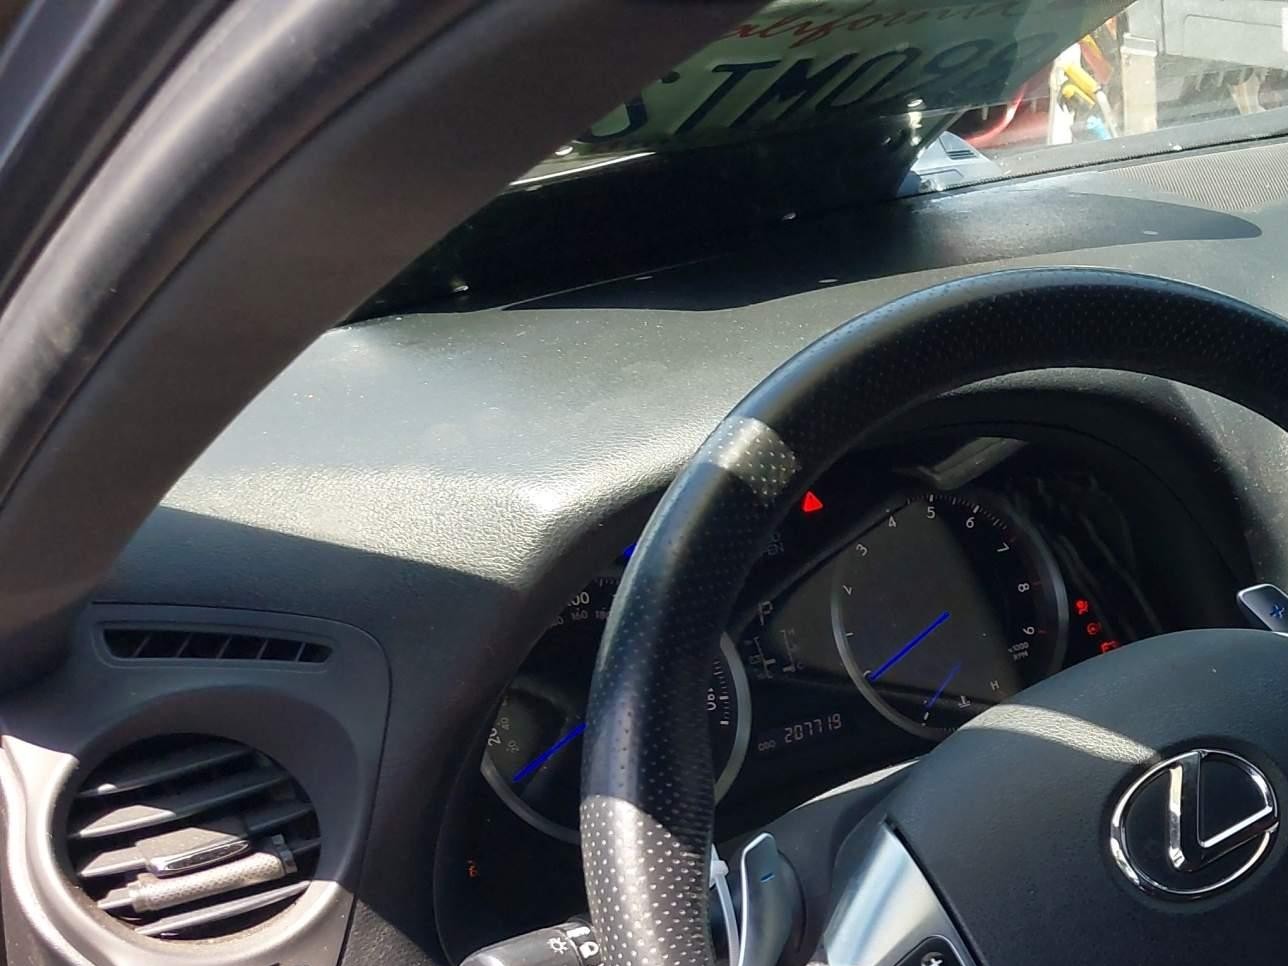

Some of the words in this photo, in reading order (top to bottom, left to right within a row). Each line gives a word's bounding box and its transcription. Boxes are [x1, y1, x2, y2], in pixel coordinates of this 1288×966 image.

[926, 506, 936, 520] 5
[887, 517, 897, 529] 4
[965, 516, 976, 530] 6
[856, 543, 868, 557] 3
[1017, 581, 1030, 593] 8
